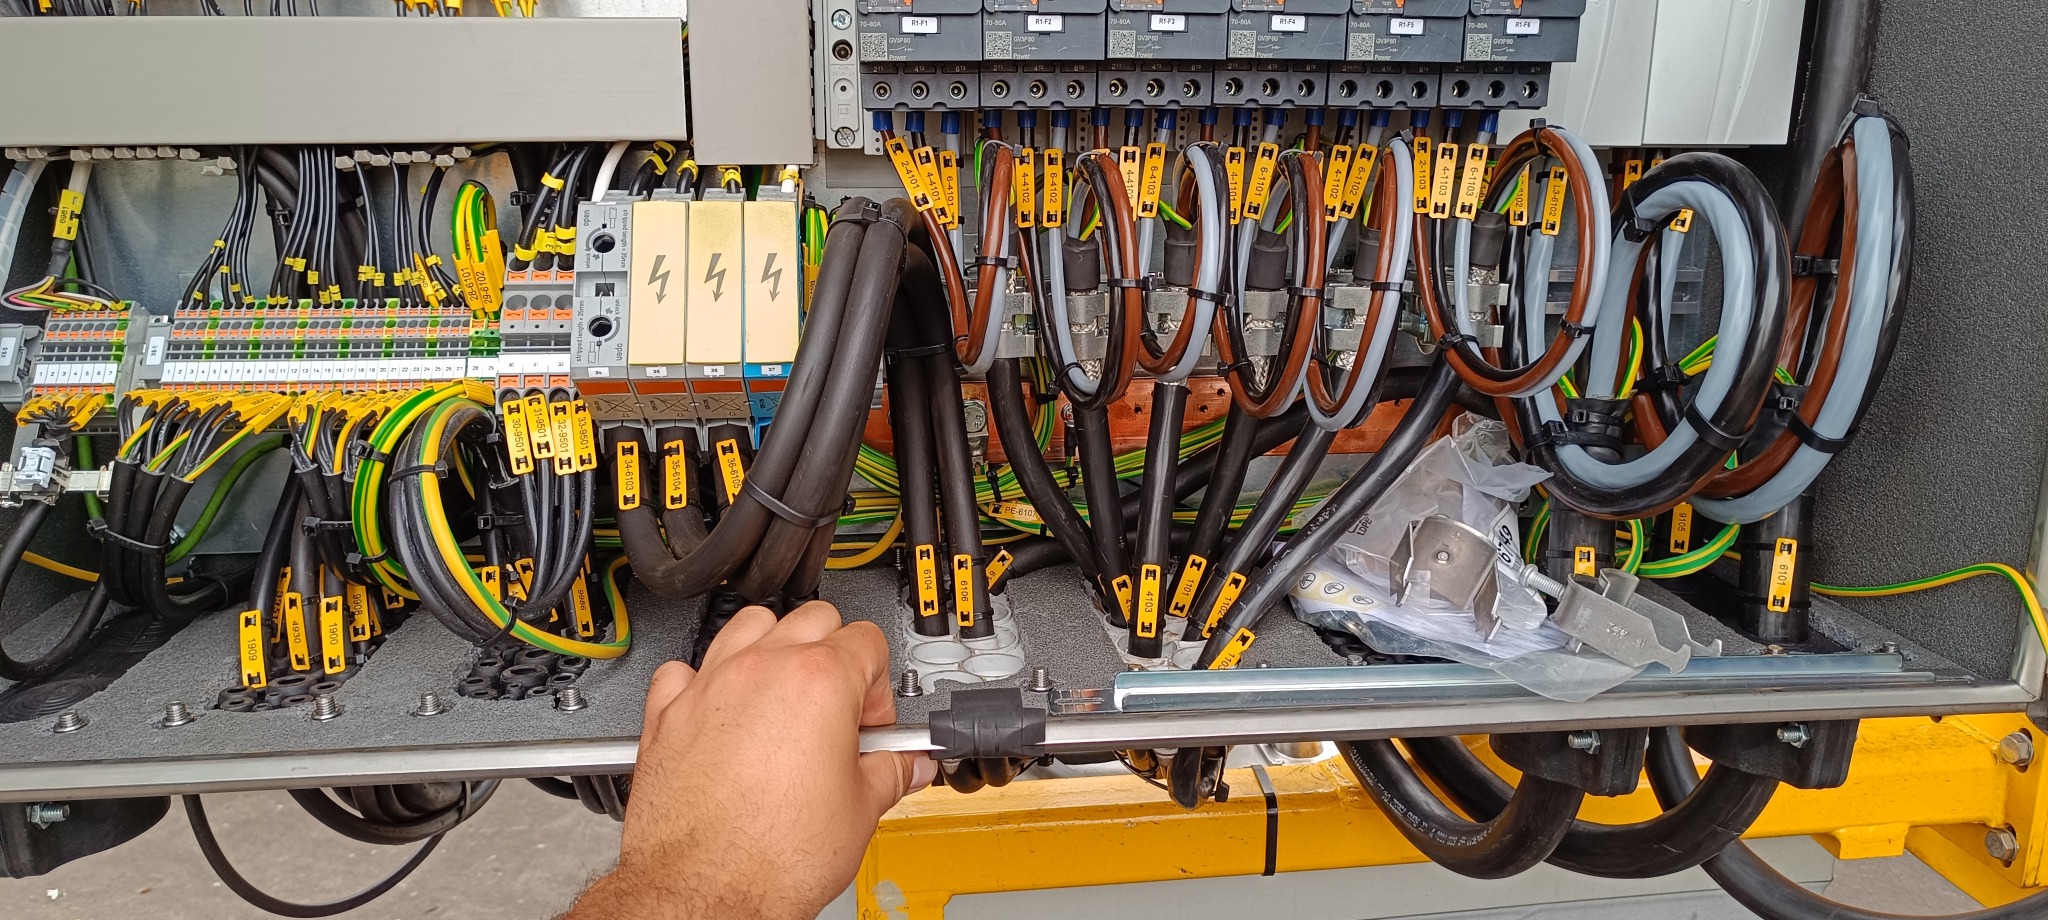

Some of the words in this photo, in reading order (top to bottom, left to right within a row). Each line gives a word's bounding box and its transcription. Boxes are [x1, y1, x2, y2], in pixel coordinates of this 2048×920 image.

[901, 160, 920, 190] 2-4101
[926, 172, 941, 202] 4-4101
[1022, 172, 1030, 204] 4-4102
[1146, 165, 1158, 196] 6-4103
[1254, 166, 1268, 197] 6-1101
[1330, 168, 1342, 200] 4-1102
[1350, 166, 1366, 196] 6-1102
[1418, 160, 1426, 190] 2-1103
[1438, 166, 1450, 196] 4-1103
[1466, 167, 1479, 196] 6-1103
[1548, 184, 1560, 216] L3-6102
[460, 266, 479, 302] 28-6101
[476, 270, 493, 305] 29-6102
[576, 322, 584, 338] length
[576, 340, 584, 362] stripped
[614, 342, 622, 361] open
[512, 418, 525, 453] 30-9501
[533, 408, 548, 440] 31-9501
[558, 420, 569, 454] 32-9501
[578, 417, 589, 450] 33-9501
[624, 459, 634, 490] 34-6103
[672, 460, 682, 491] 35-6104
[727, 458, 742, 489] 36-6105
[1356, 518, 1372, 536] LDPE
[1678, 512, 1687, 532] 9105
[924, 568, 933, 591] 6104
[960, 580, 968, 602] 6106
[1181, 579, 1194, 596] 1101
[1776, 564, 1788, 588] 6101
[1145, 590, 1154, 613] 4103
[1217, 596, 1232, 618] 1102
[292, 620, 302, 644] 4930
[330, 622, 338, 646] 1900
[248, 638, 258, 661] 1909
